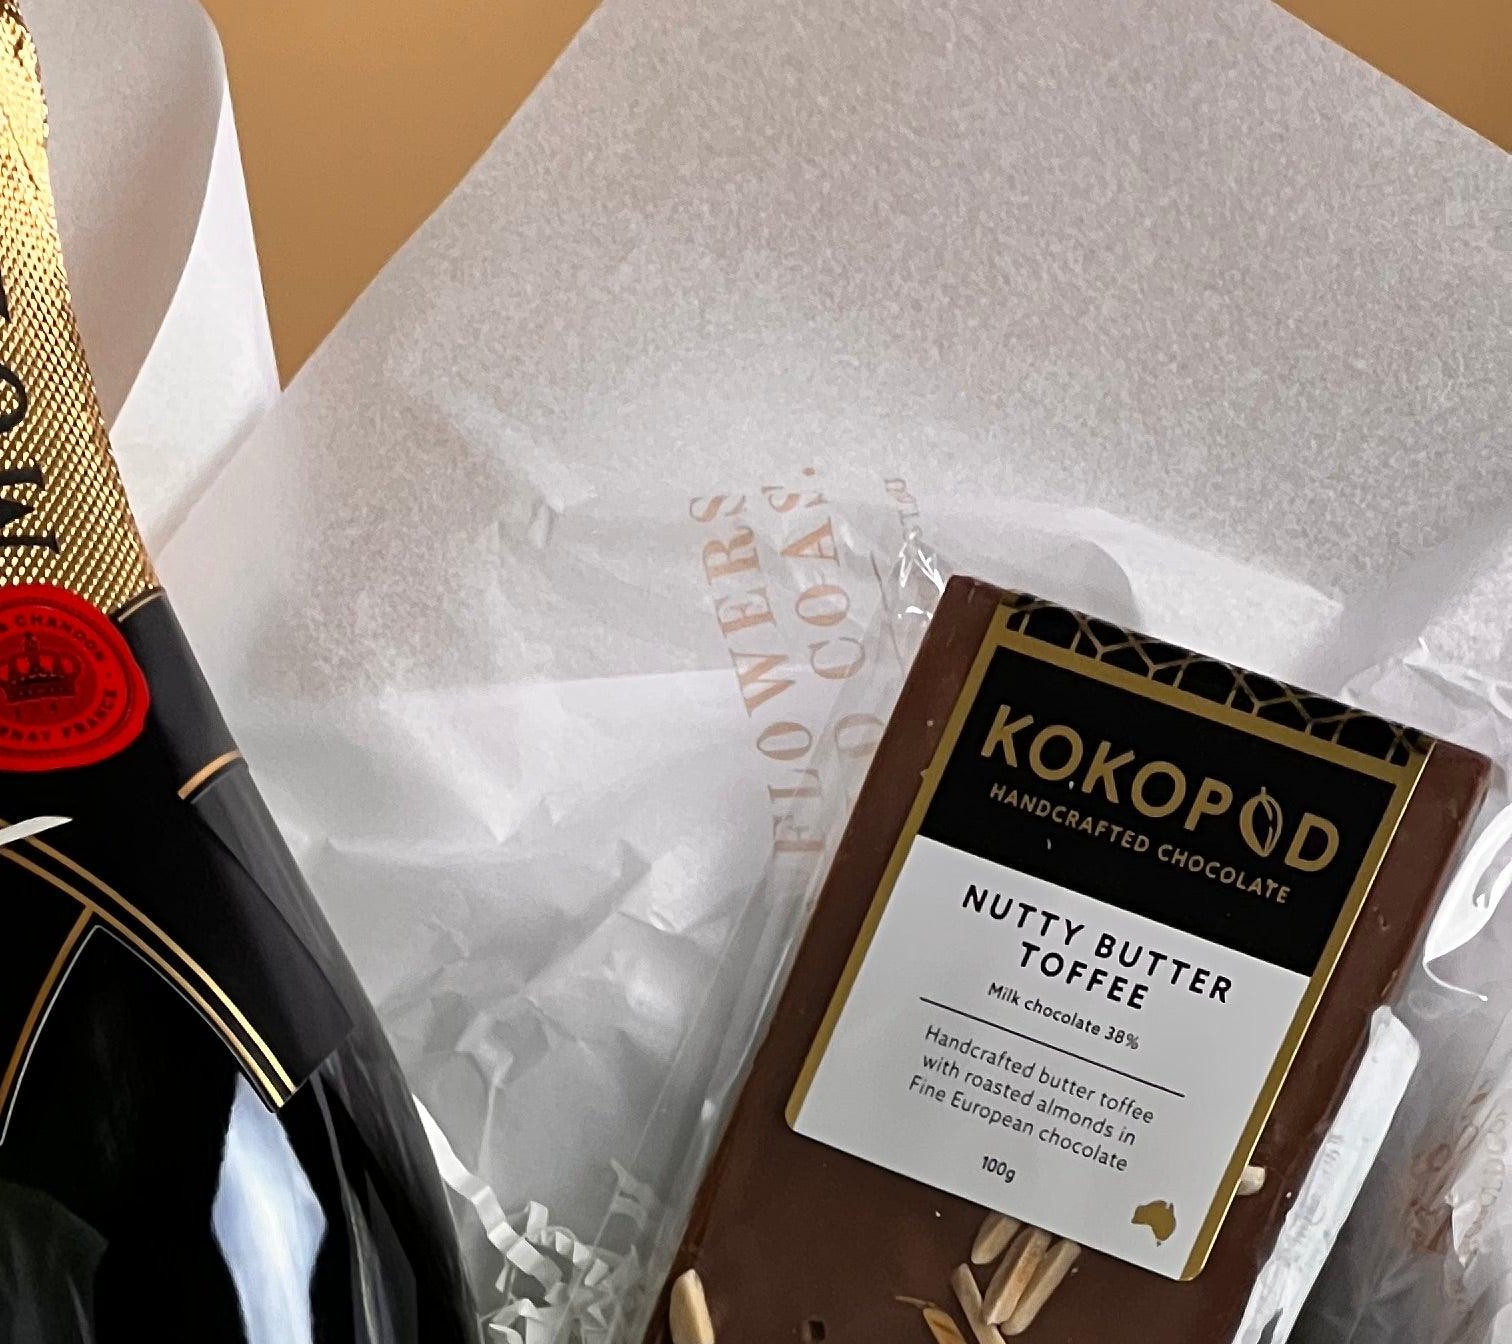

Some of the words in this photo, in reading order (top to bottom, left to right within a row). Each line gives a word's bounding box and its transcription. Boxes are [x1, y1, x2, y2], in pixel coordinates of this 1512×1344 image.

[690, 494, 826, 854] FLOWERS
[980, 704, 1339, 872] KOKOPOD
[990, 783, 1151, 852] HANDCRAFTED
[1157, 844, 1291, 904] CHOCOLATE
[962, 884, 1085, 946] NUTTY
[1094, 933, 1232, 1003] BUTTER
[1020, 941, 1149, 1010] TOFFEE
[987, 982, 1021, 1007] Milk
[1024, 998, 1101, 1036] chocolate
[1104, 1025, 1140, 1050] 38%
[923, 1054, 960, 1079] with
[964, 1071, 1036, 1106] roasted
[1037, 1098, 1114, 1138] almonds
[1119, 1127, 1136, 1146] in
[925, 1024, 1036, 1079] Handcrafted
[1038, 1066, 1096, 1101] butter
[1099, 1093, 1154, 1124] toffee
[908, 1075, 946, 1102] Fine
[950, 1090, 1034, 1136] European
[1038, 1126, 1128, 1172] chocolate
[982, 1155, 1016, 1184] 100g
